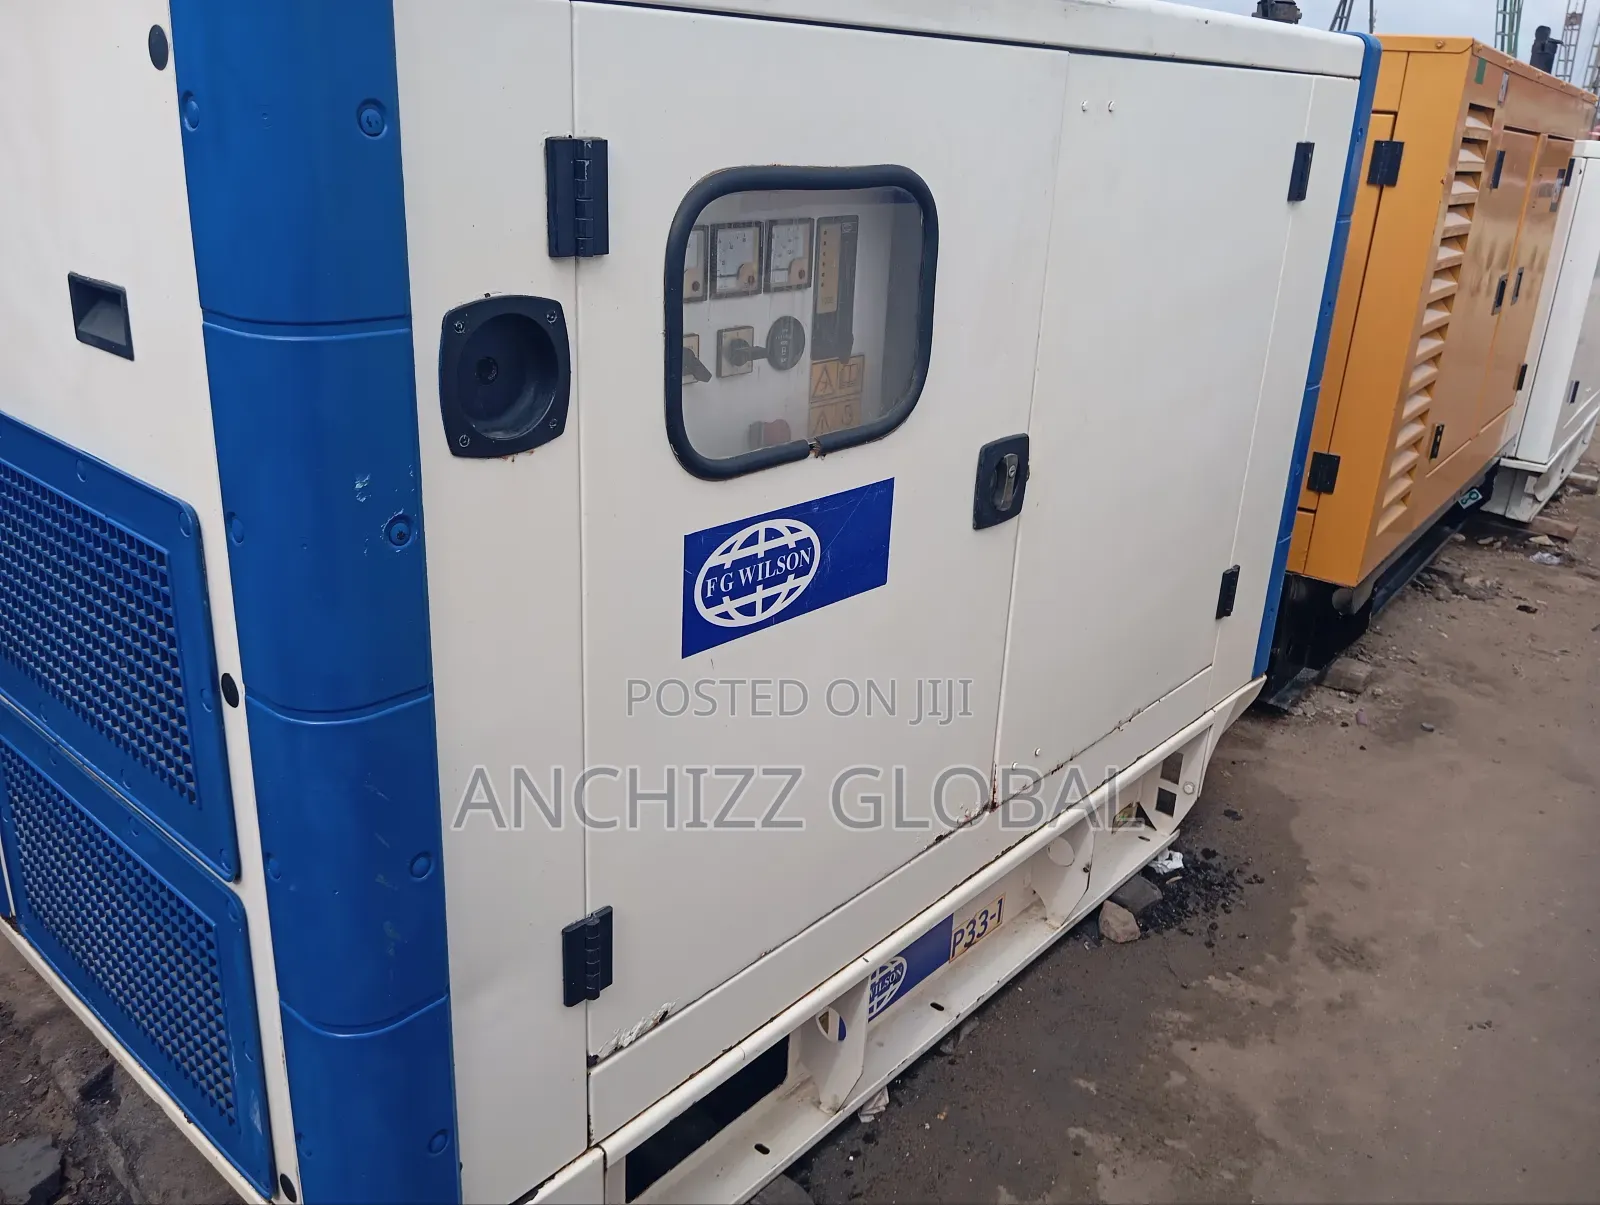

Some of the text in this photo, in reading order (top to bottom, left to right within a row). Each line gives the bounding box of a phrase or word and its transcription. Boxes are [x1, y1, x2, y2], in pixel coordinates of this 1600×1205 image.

[705, 546, 812, 599] FG WILSON
[951, 897, 1003, 959] P33-1
